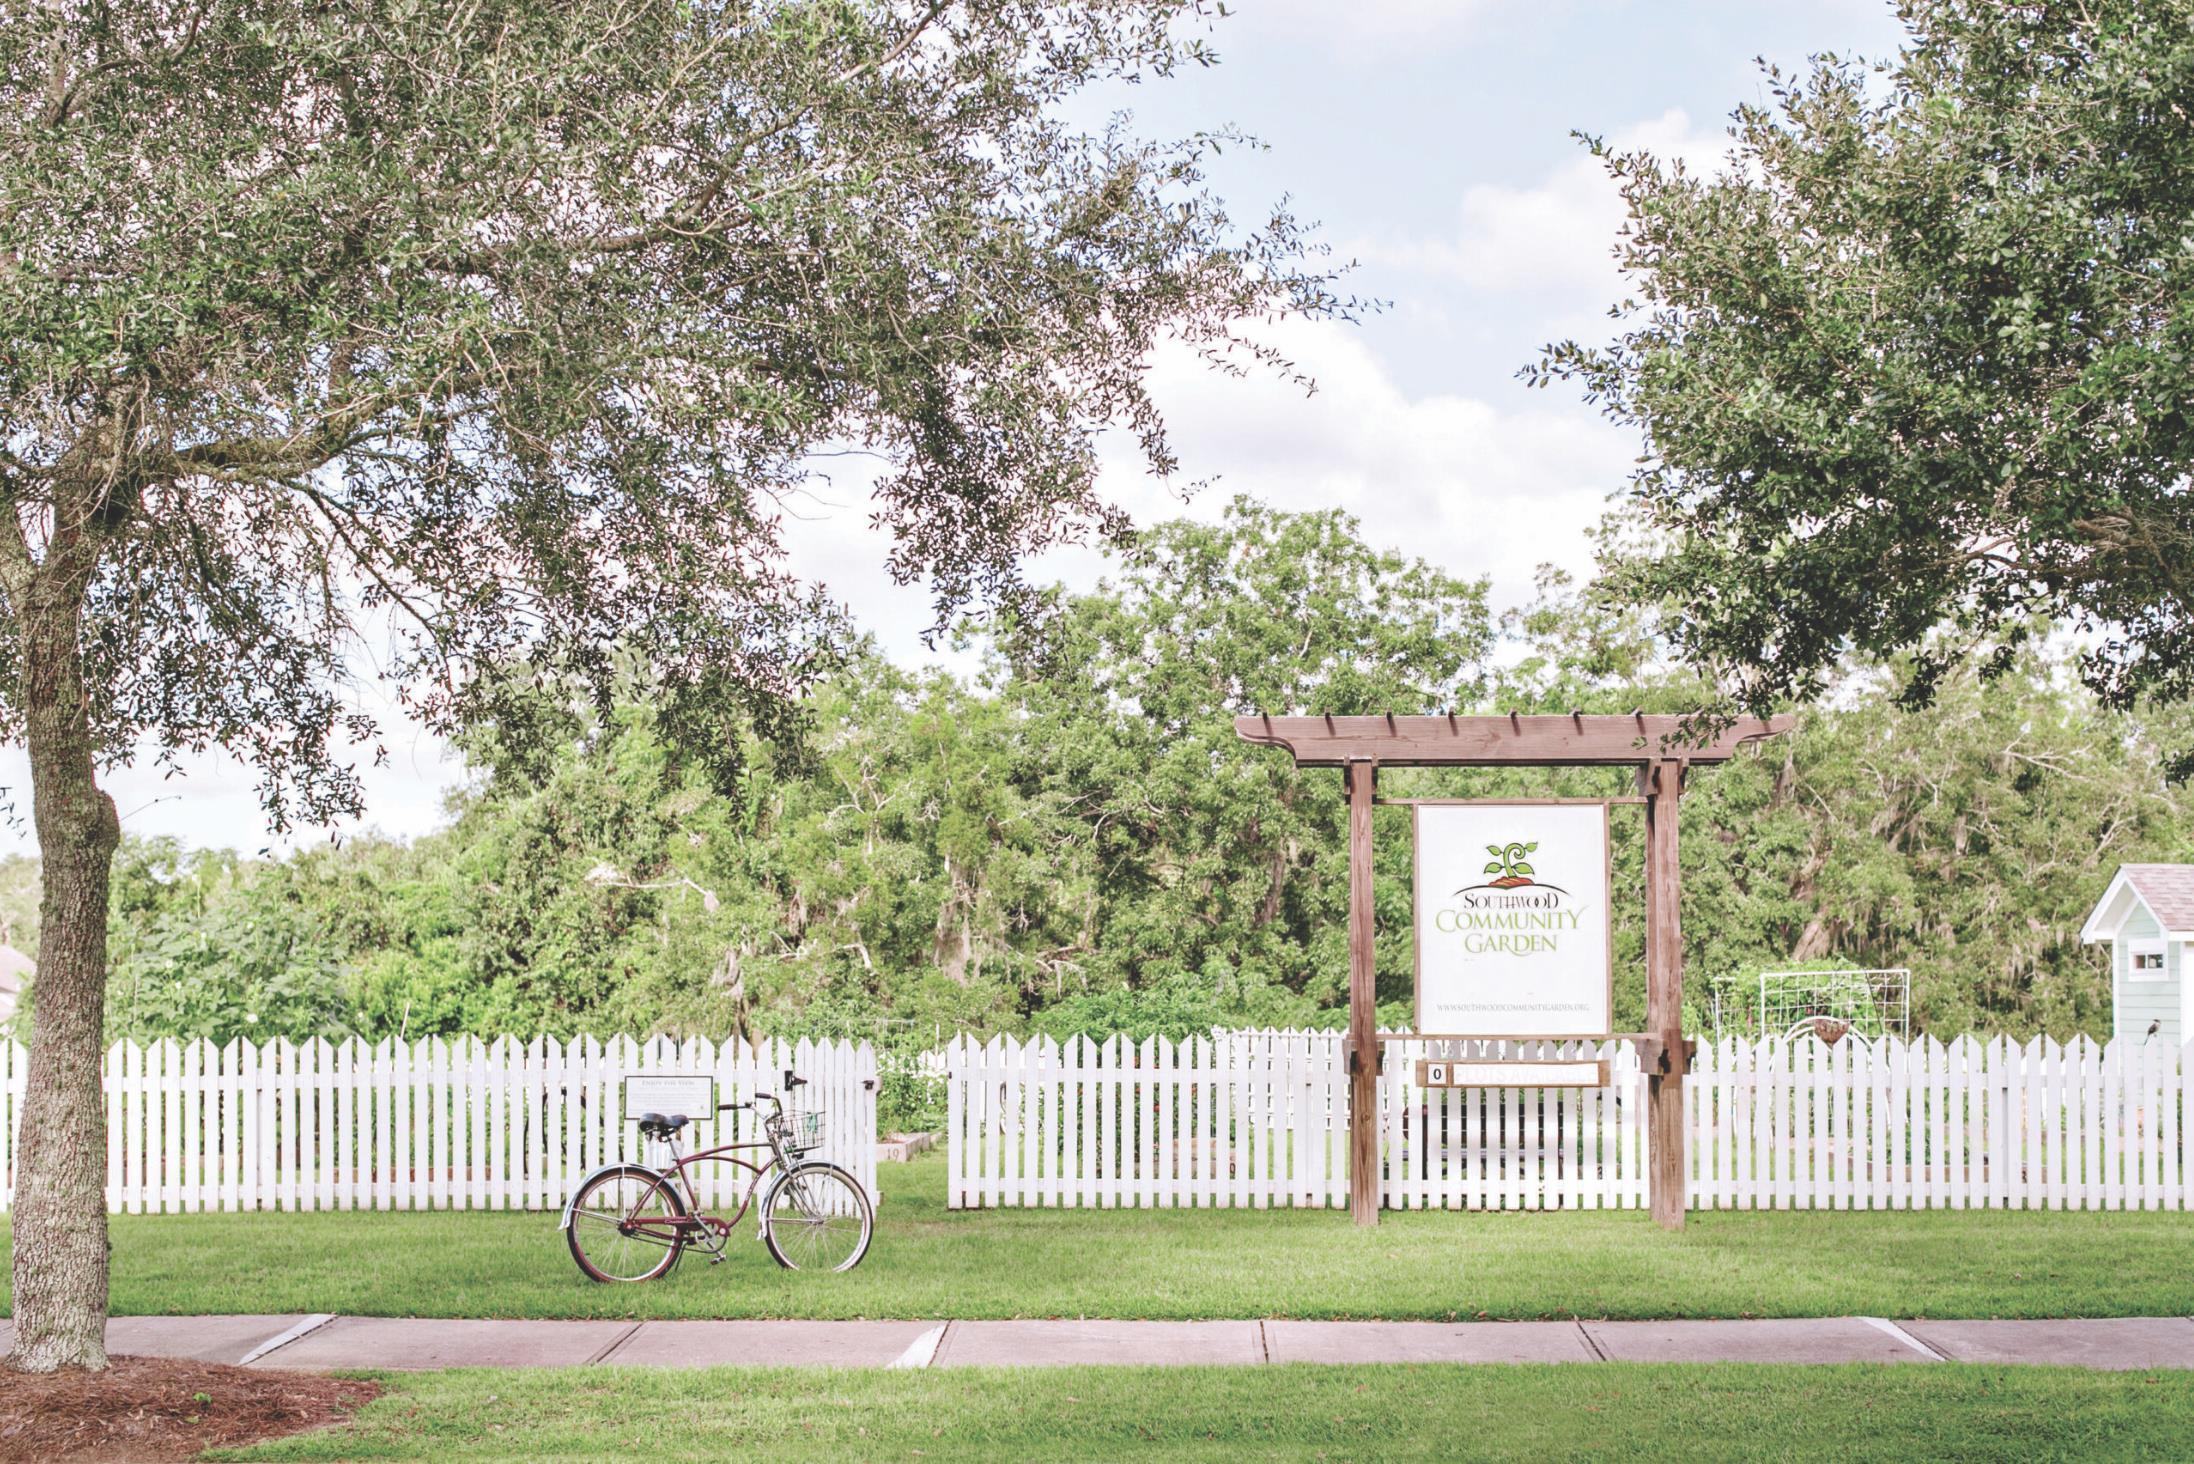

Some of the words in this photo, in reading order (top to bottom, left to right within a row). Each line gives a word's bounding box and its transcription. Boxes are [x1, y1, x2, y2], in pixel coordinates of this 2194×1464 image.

[1464, 893, 1558, 909] SOUTHWOOD
[1435, 905, 1588, 932] COMMUNITY
[1464, 933, 1557, 956] GARDEN
[1433, 1068, 1442, 1080] 0
